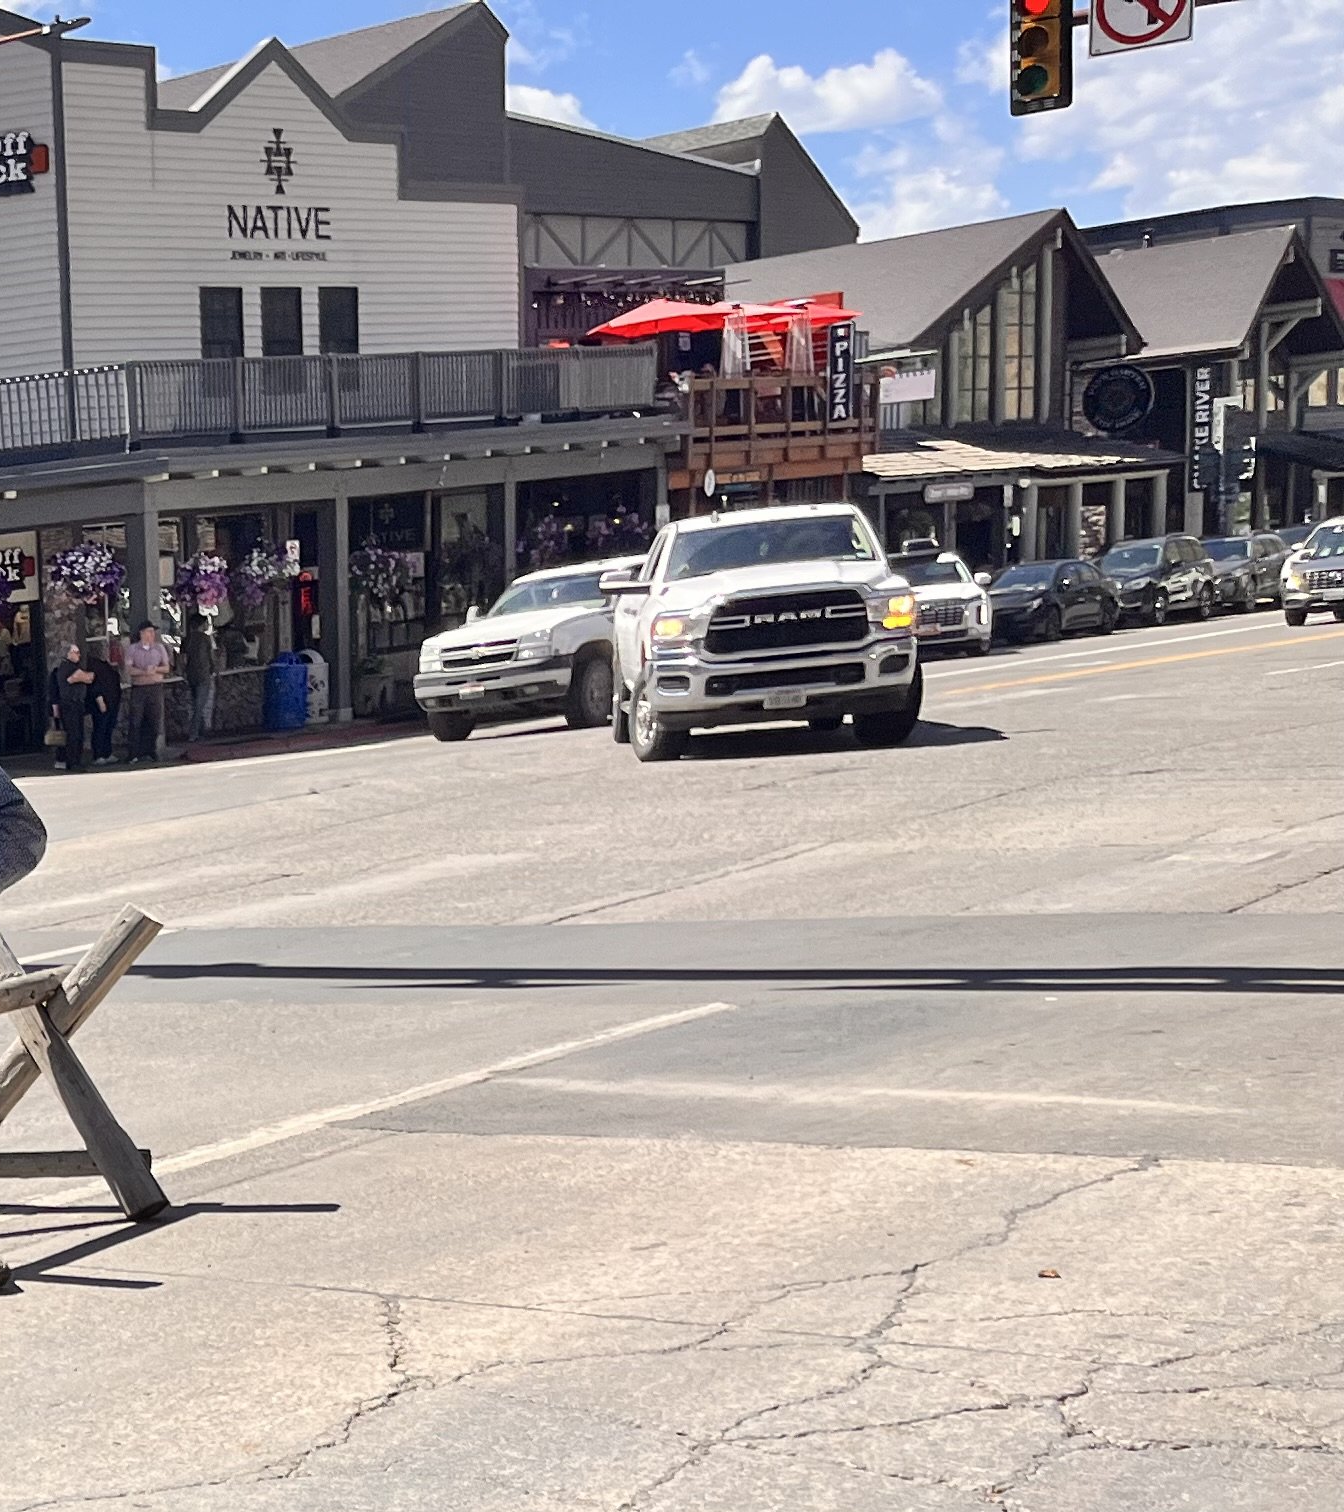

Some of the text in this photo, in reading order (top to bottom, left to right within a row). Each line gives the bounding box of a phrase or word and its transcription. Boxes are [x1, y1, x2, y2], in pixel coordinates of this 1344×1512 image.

[227, 204, 331, 240] NATIVE
[832, 341, 849, 420] PIZZA
[1195, 367, 1211, 423] RIVER
[754, 609, 822, 624] RAM
